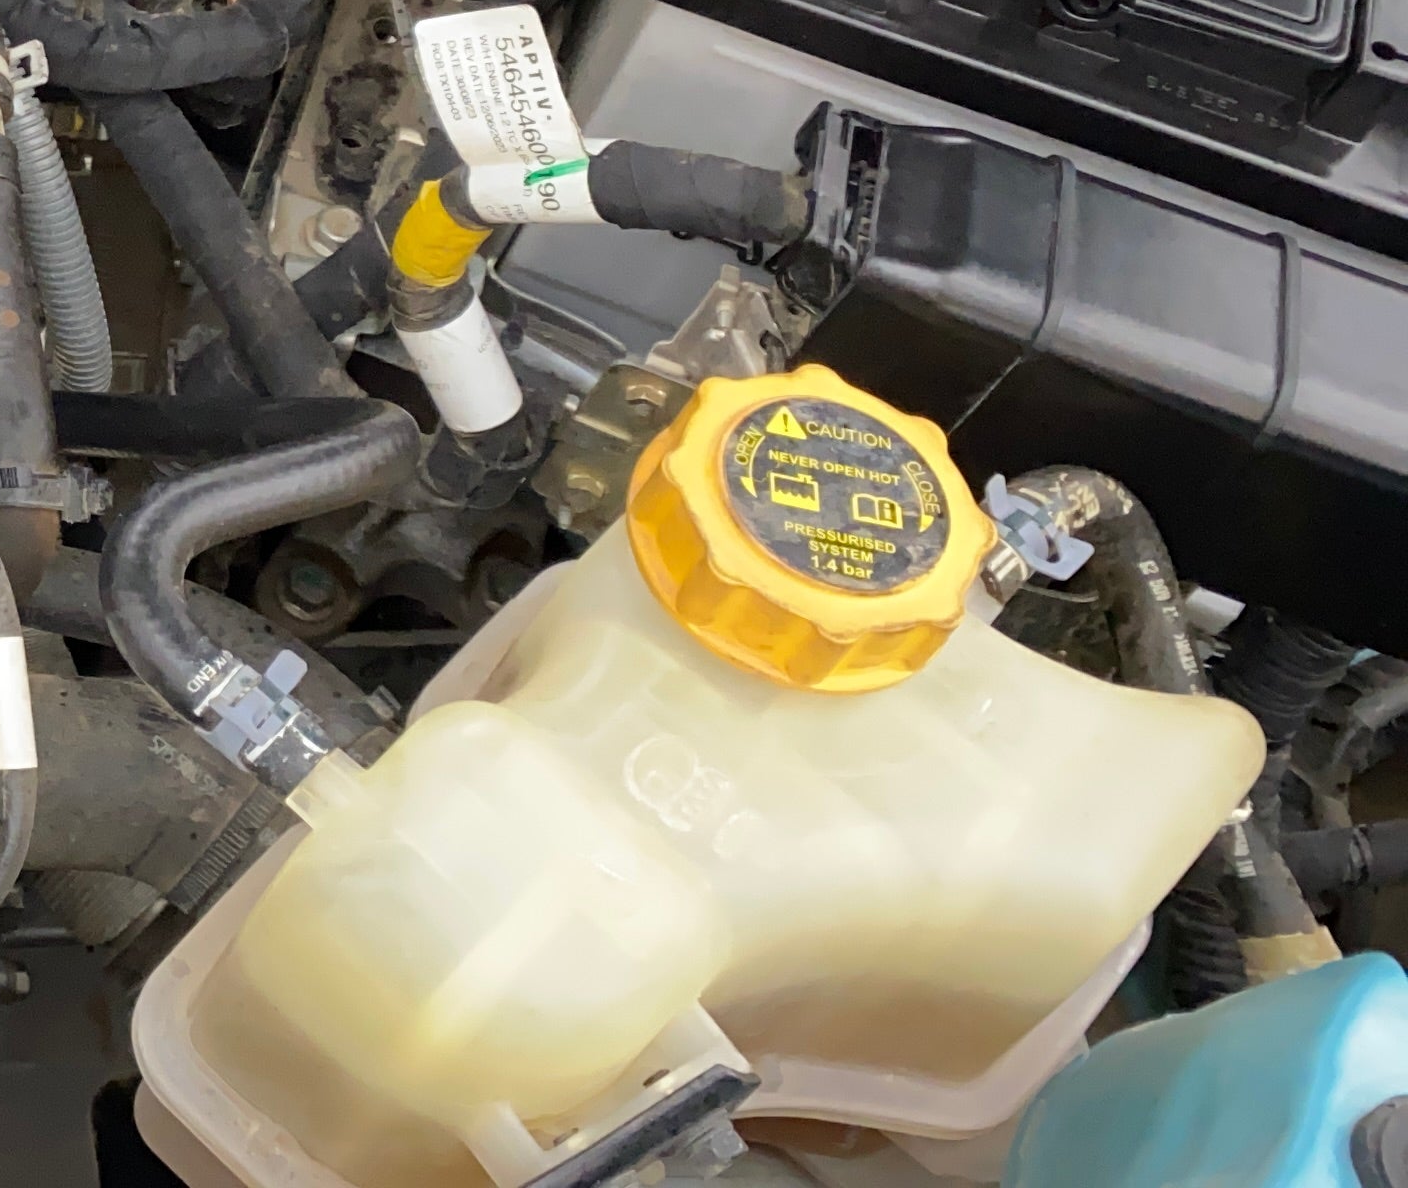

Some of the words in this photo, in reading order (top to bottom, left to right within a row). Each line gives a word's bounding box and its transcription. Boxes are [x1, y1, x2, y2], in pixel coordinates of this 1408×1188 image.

[518, 35, 553, 111] APTIV
[495, 36, 561, 212] 546454600190
[733, 425, 763, 466] OPEN
[805, 419, 893, 451] CAUTION
[768, 449, 820, 473] NEVER
[822, 460, 866, 480] OPEN
[868, 469, 901, 487] HOT
[904, 459, 942, 514] CLOSE
[784, 520, 896, 555] PRESSURISED
[808, 539, 874, 564] SYSTEM
[810, 554, 839, 573] 1.4
[842, 560, 875, 580] bar
